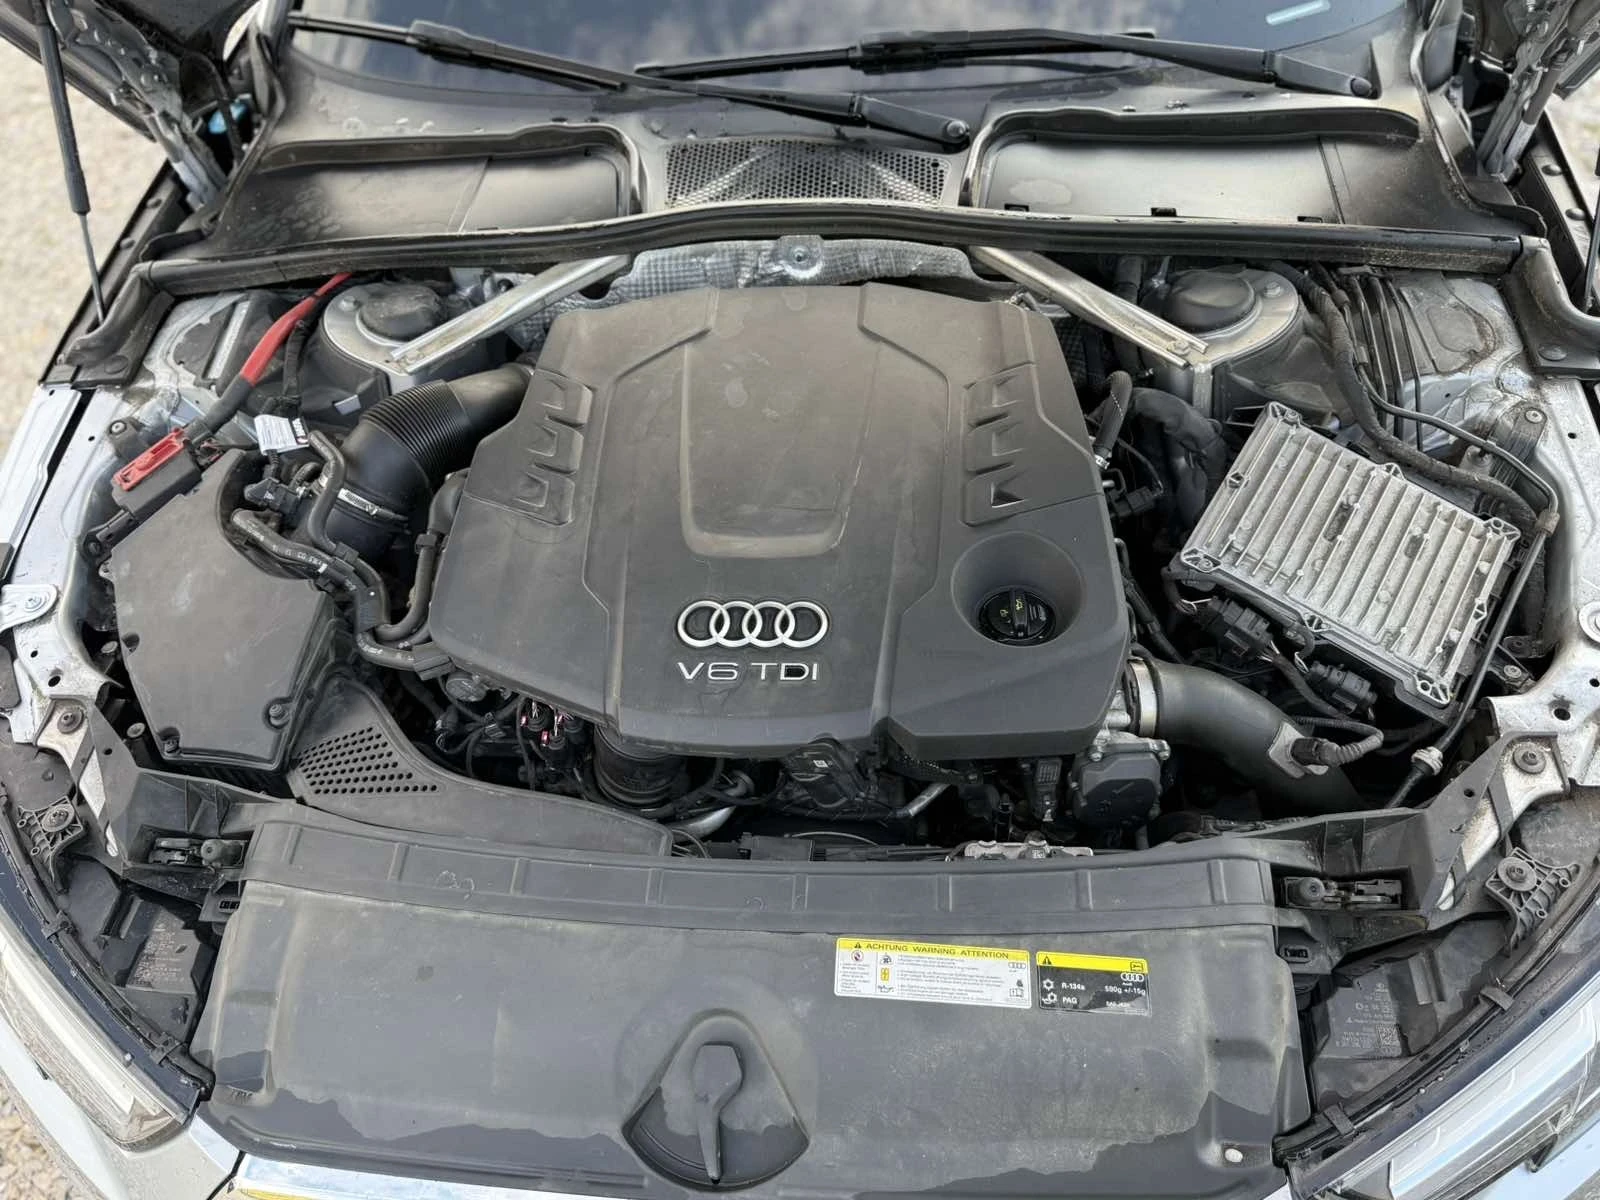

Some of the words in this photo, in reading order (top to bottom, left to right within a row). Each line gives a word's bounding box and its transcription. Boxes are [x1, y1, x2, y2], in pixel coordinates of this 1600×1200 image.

[677, 662, 739, 680] V6
[751, 662, 818, 680] TDI
[866, 943, 909, 952] ACHTUNG
[913, 946, 956, 956] WARNING
[961, 949, 1009, 959] ATTENTION
[1061, 982, 1086, 991] R-134a
[1062, 996, 1078, 1005] PAG
